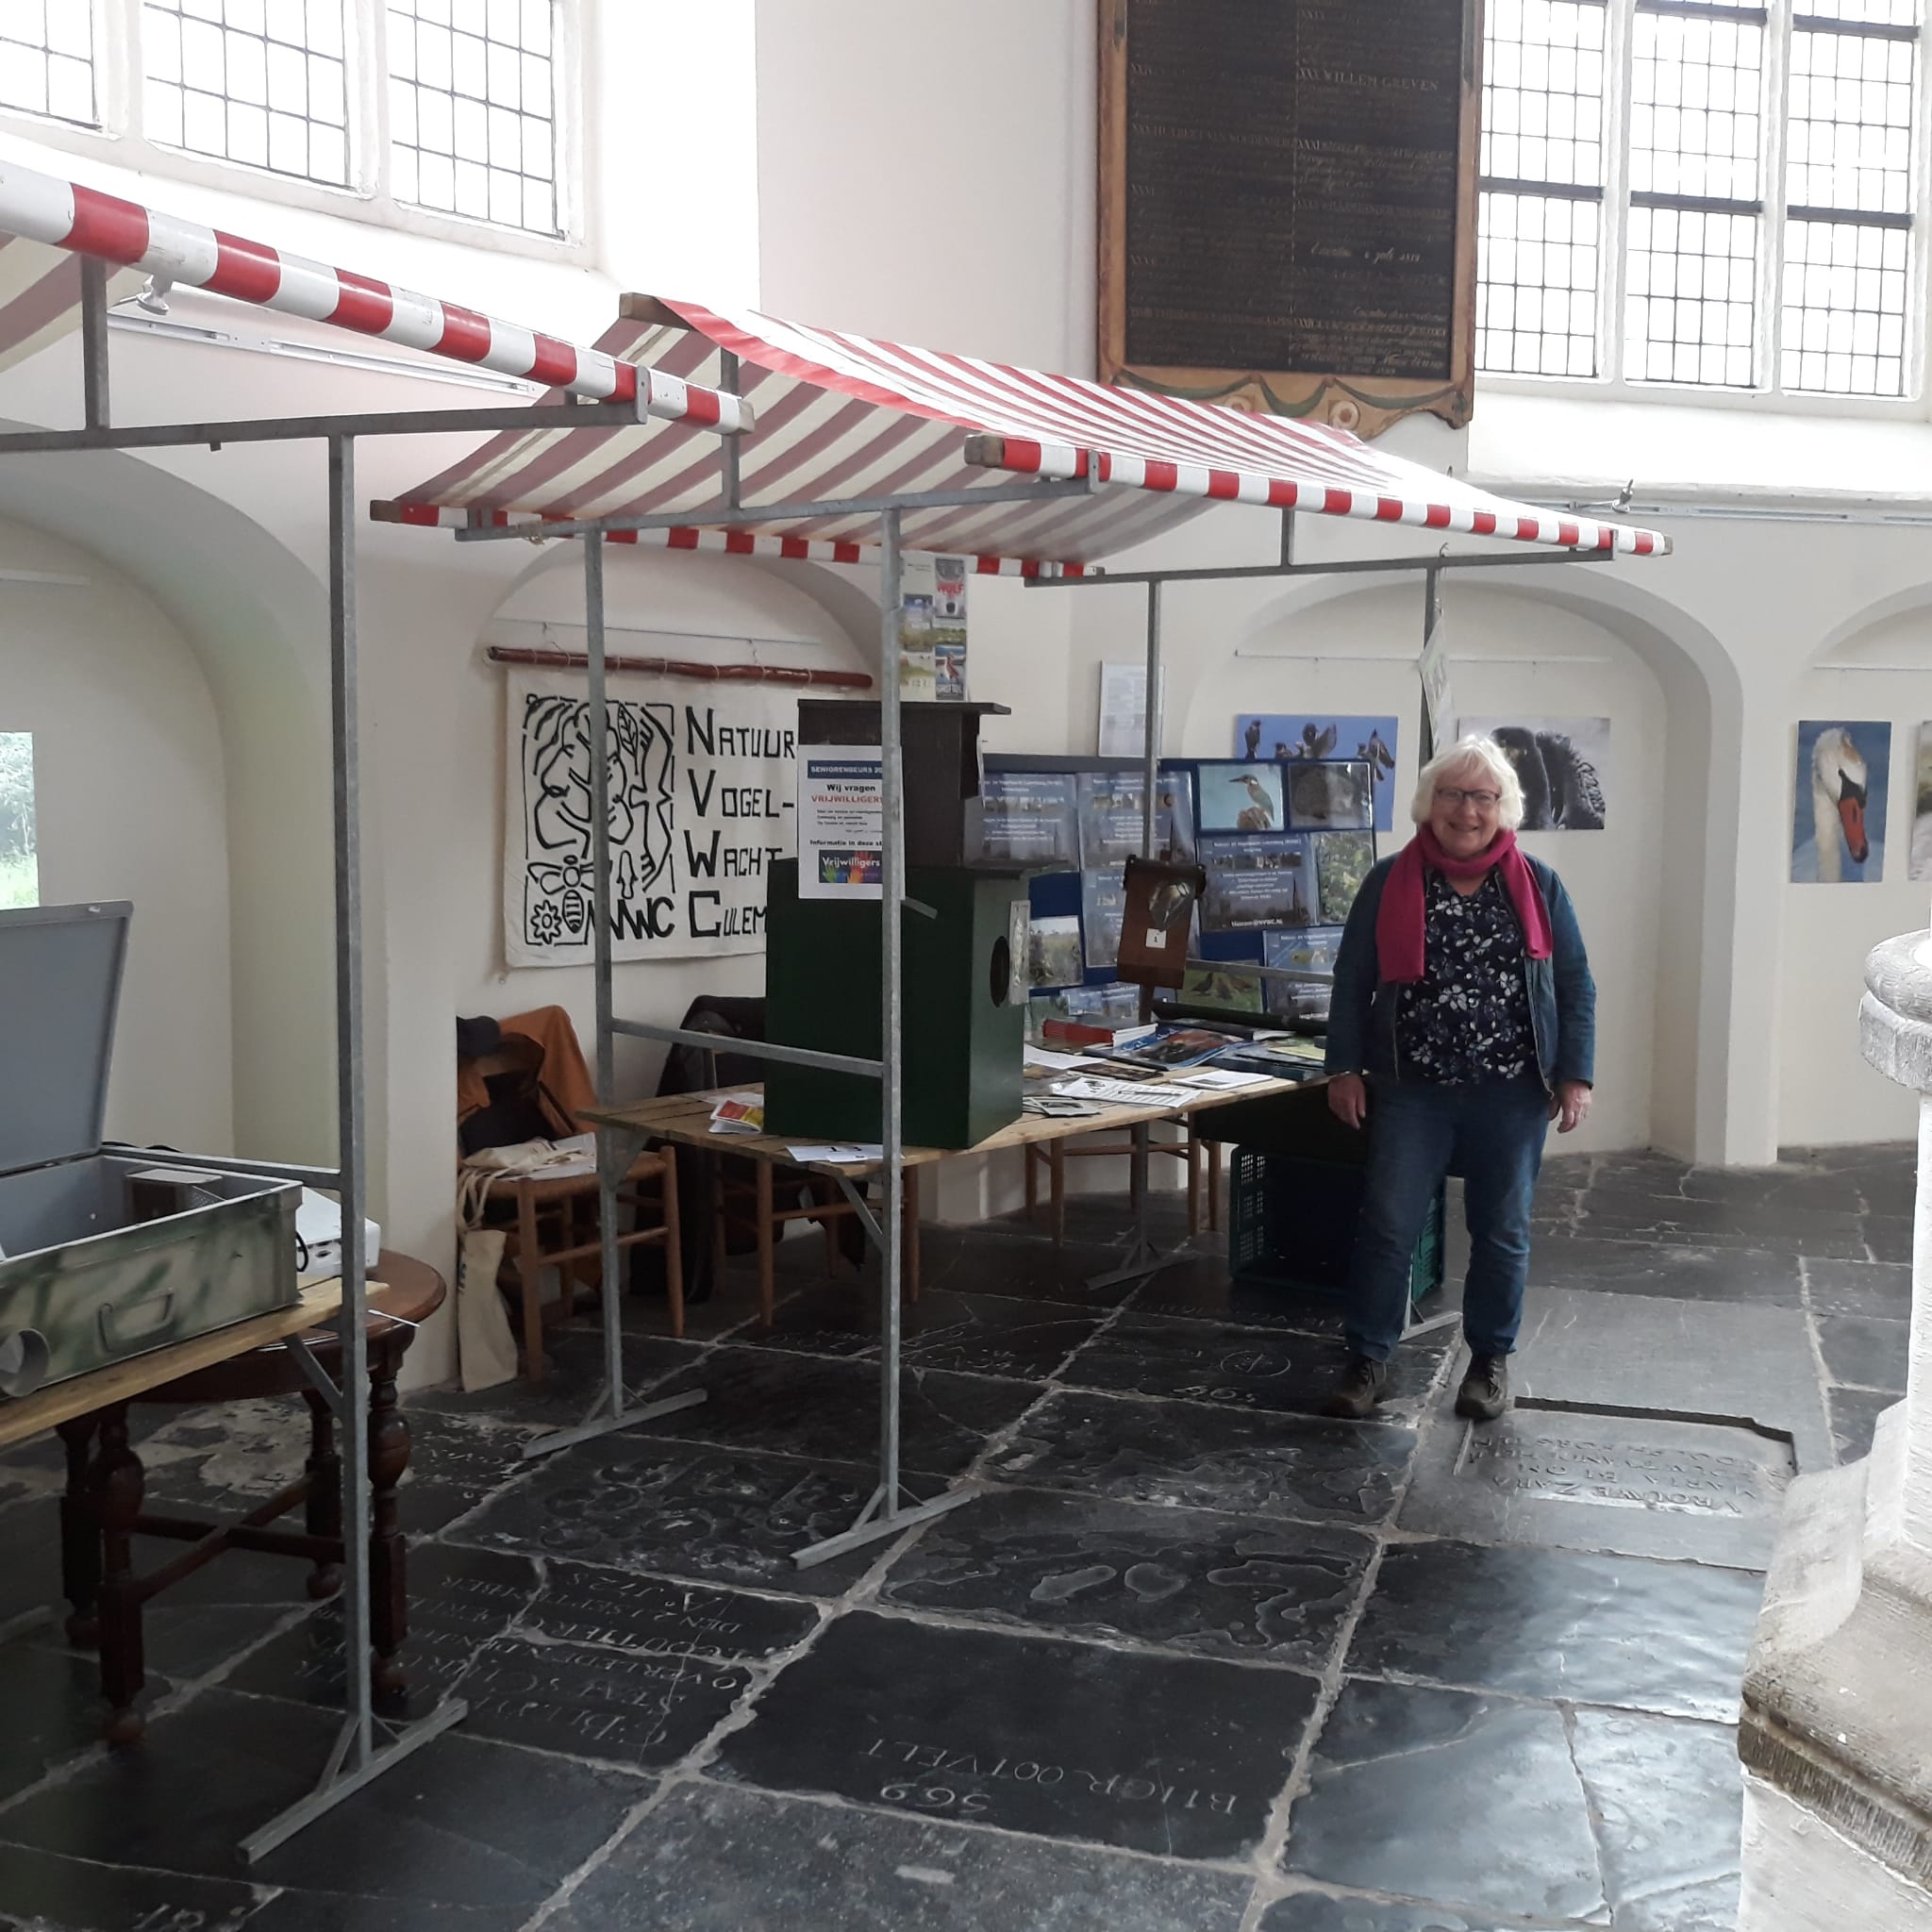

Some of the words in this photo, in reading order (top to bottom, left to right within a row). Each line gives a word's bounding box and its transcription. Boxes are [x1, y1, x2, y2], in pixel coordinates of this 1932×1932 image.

[1324, 69, 1377, 90] WILLEM
[686, 706, 796, 758] NATUUR
[687, 768, 795, 819] VOGEL-
[826, 784, 842, 793] Wij
[844, 785, 876, 794] vragen
[822, 856, 880, 869] Vrijwilligers
